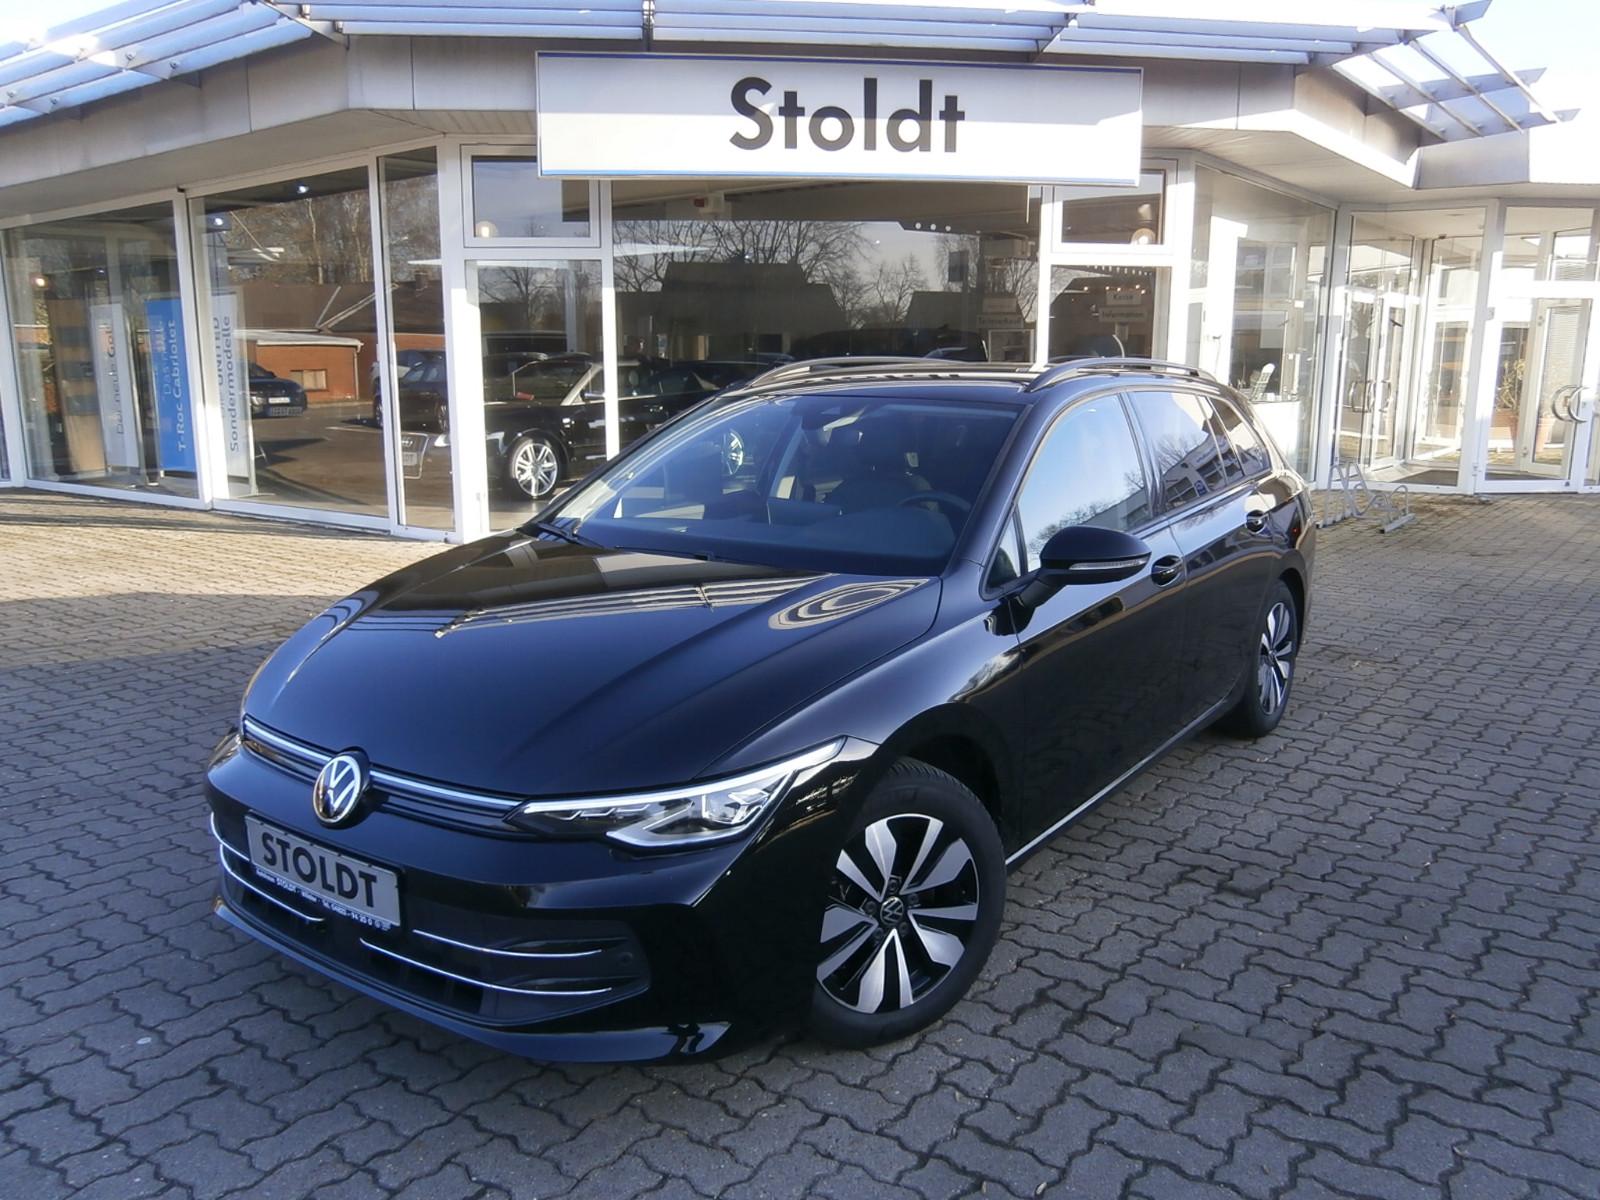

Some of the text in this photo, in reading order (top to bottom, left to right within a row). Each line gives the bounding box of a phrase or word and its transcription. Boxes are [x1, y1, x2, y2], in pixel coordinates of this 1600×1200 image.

[729, 76, 965, 153] Stoldt
[168, 320, 186, 451] T-Roc Cabriolet
[222, 316, 239, 452] Sondermodelle
[262, 832, 377, 907] STOLDT
